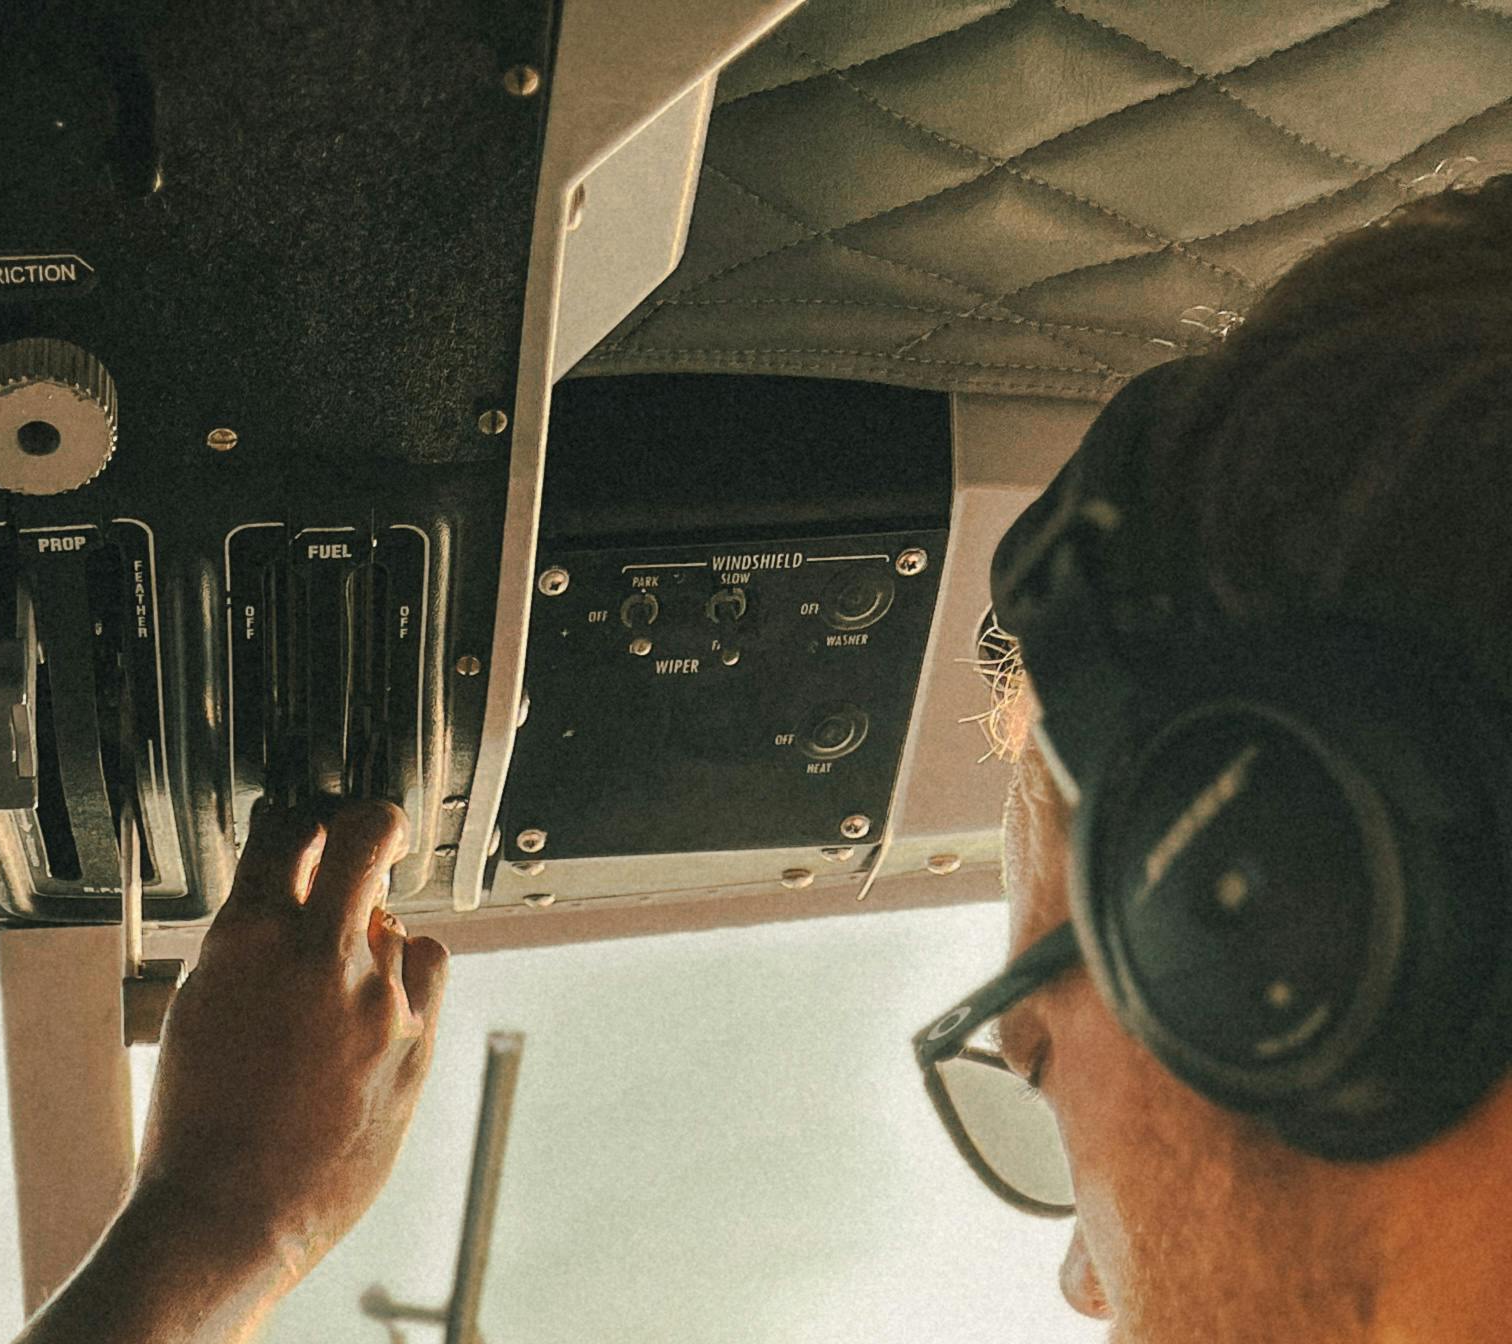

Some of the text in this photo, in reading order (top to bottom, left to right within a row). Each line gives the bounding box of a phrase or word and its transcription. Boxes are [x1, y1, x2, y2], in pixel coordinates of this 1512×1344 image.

[38, 536, 87, 552] PROP
[308, 543, 353, 559] FUEL
[711, 552, 804, 572] WINDSHIELD
[631, 575, 660, 588] PARK
[720, 572, 751, 585] SLOW
[133, 560, 148, 639] FEATHER
[244, 605, 256, 640] OFF
[399, 605, 410, 639] OFF
[587, 610, 608, 623] OFF
[826, 633, 869, 647] WASHER
[655, 658, 700, 675] WIPER
[774, 733, 795, 746] OFF
[806, 762, 833, 775] HEAT
